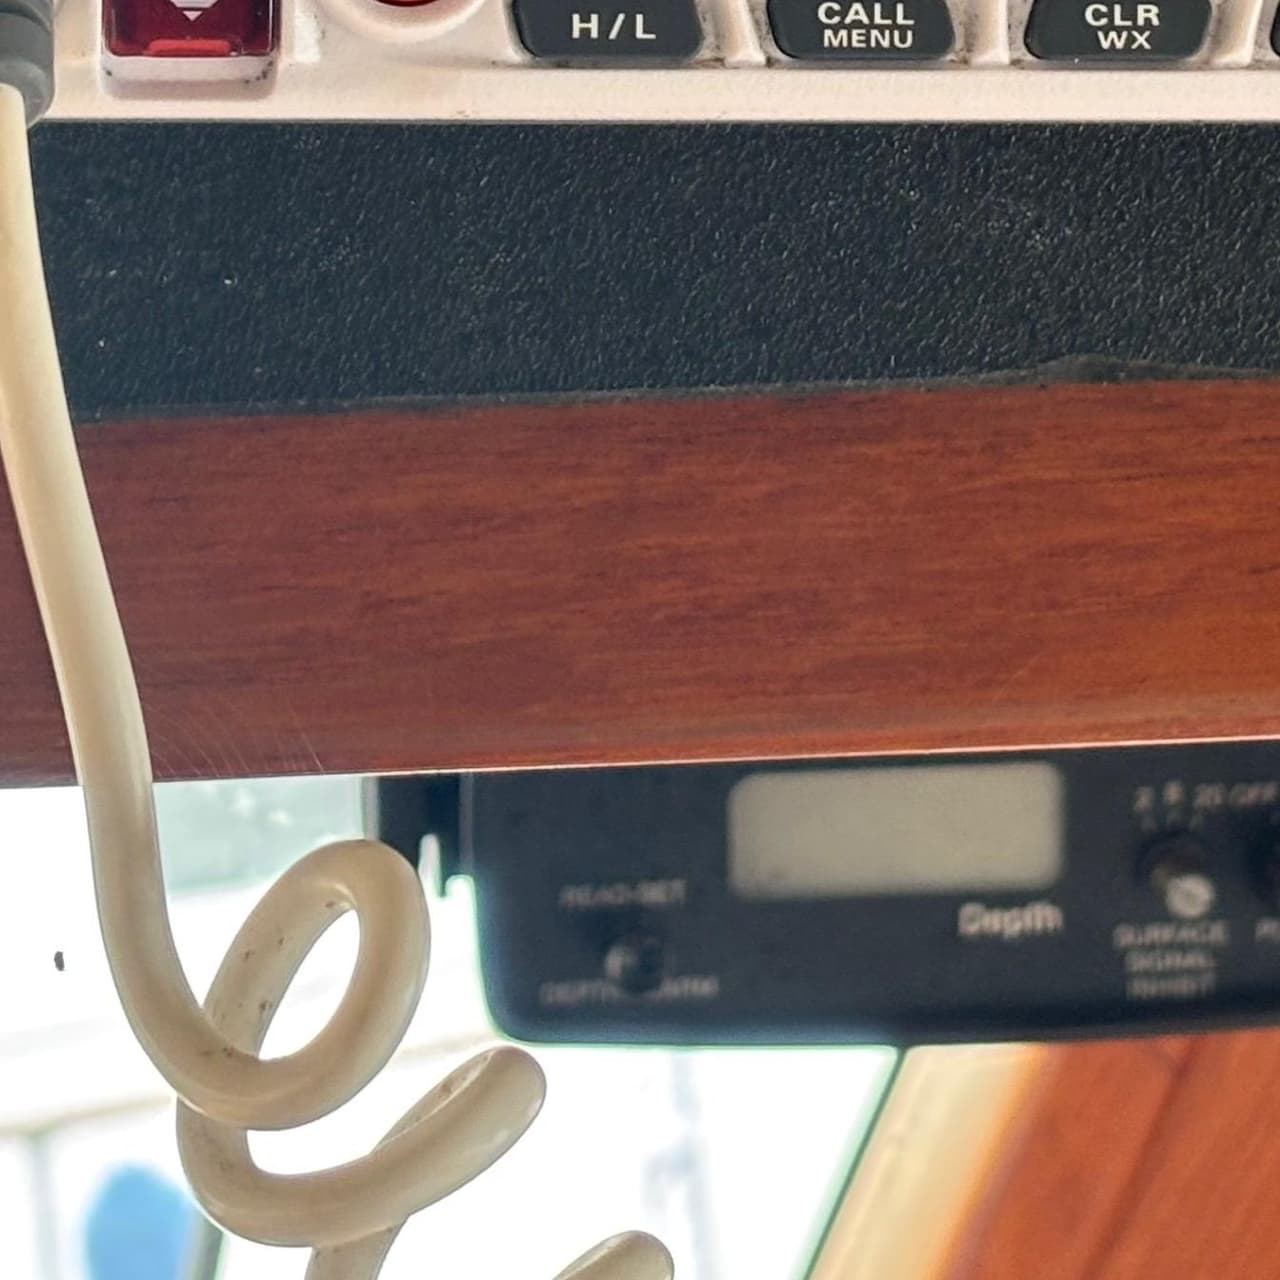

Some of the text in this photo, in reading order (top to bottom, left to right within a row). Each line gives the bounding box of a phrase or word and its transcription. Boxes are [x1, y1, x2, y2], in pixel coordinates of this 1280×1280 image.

[816, 1, 916, 26] CALL
[1084, 3, 1162, 28] CLR
[822, 28, 914, 50] MENU
[1097, 30, 1152, 51] WX
[958, 897, 1064, 941] Depth
